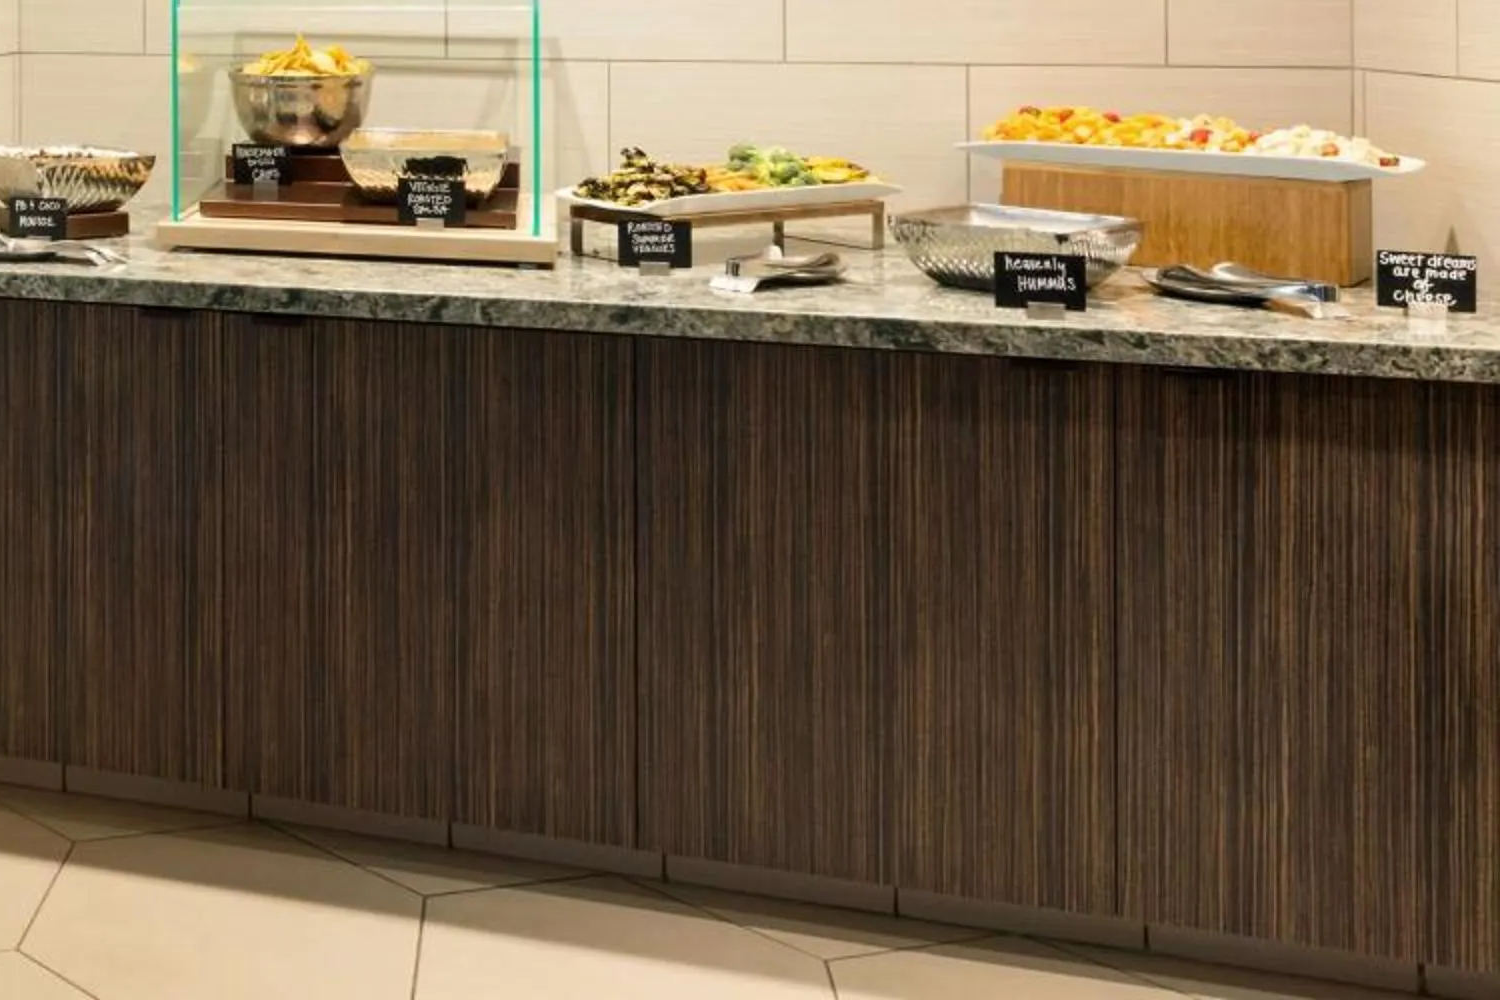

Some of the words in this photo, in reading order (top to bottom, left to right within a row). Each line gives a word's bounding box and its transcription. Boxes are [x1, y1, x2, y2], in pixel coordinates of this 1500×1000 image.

[1379, 251, 1425, 267] Sweet
[1392, 266, 1420, 278] are
[1424, 267, 1468, 281] made
